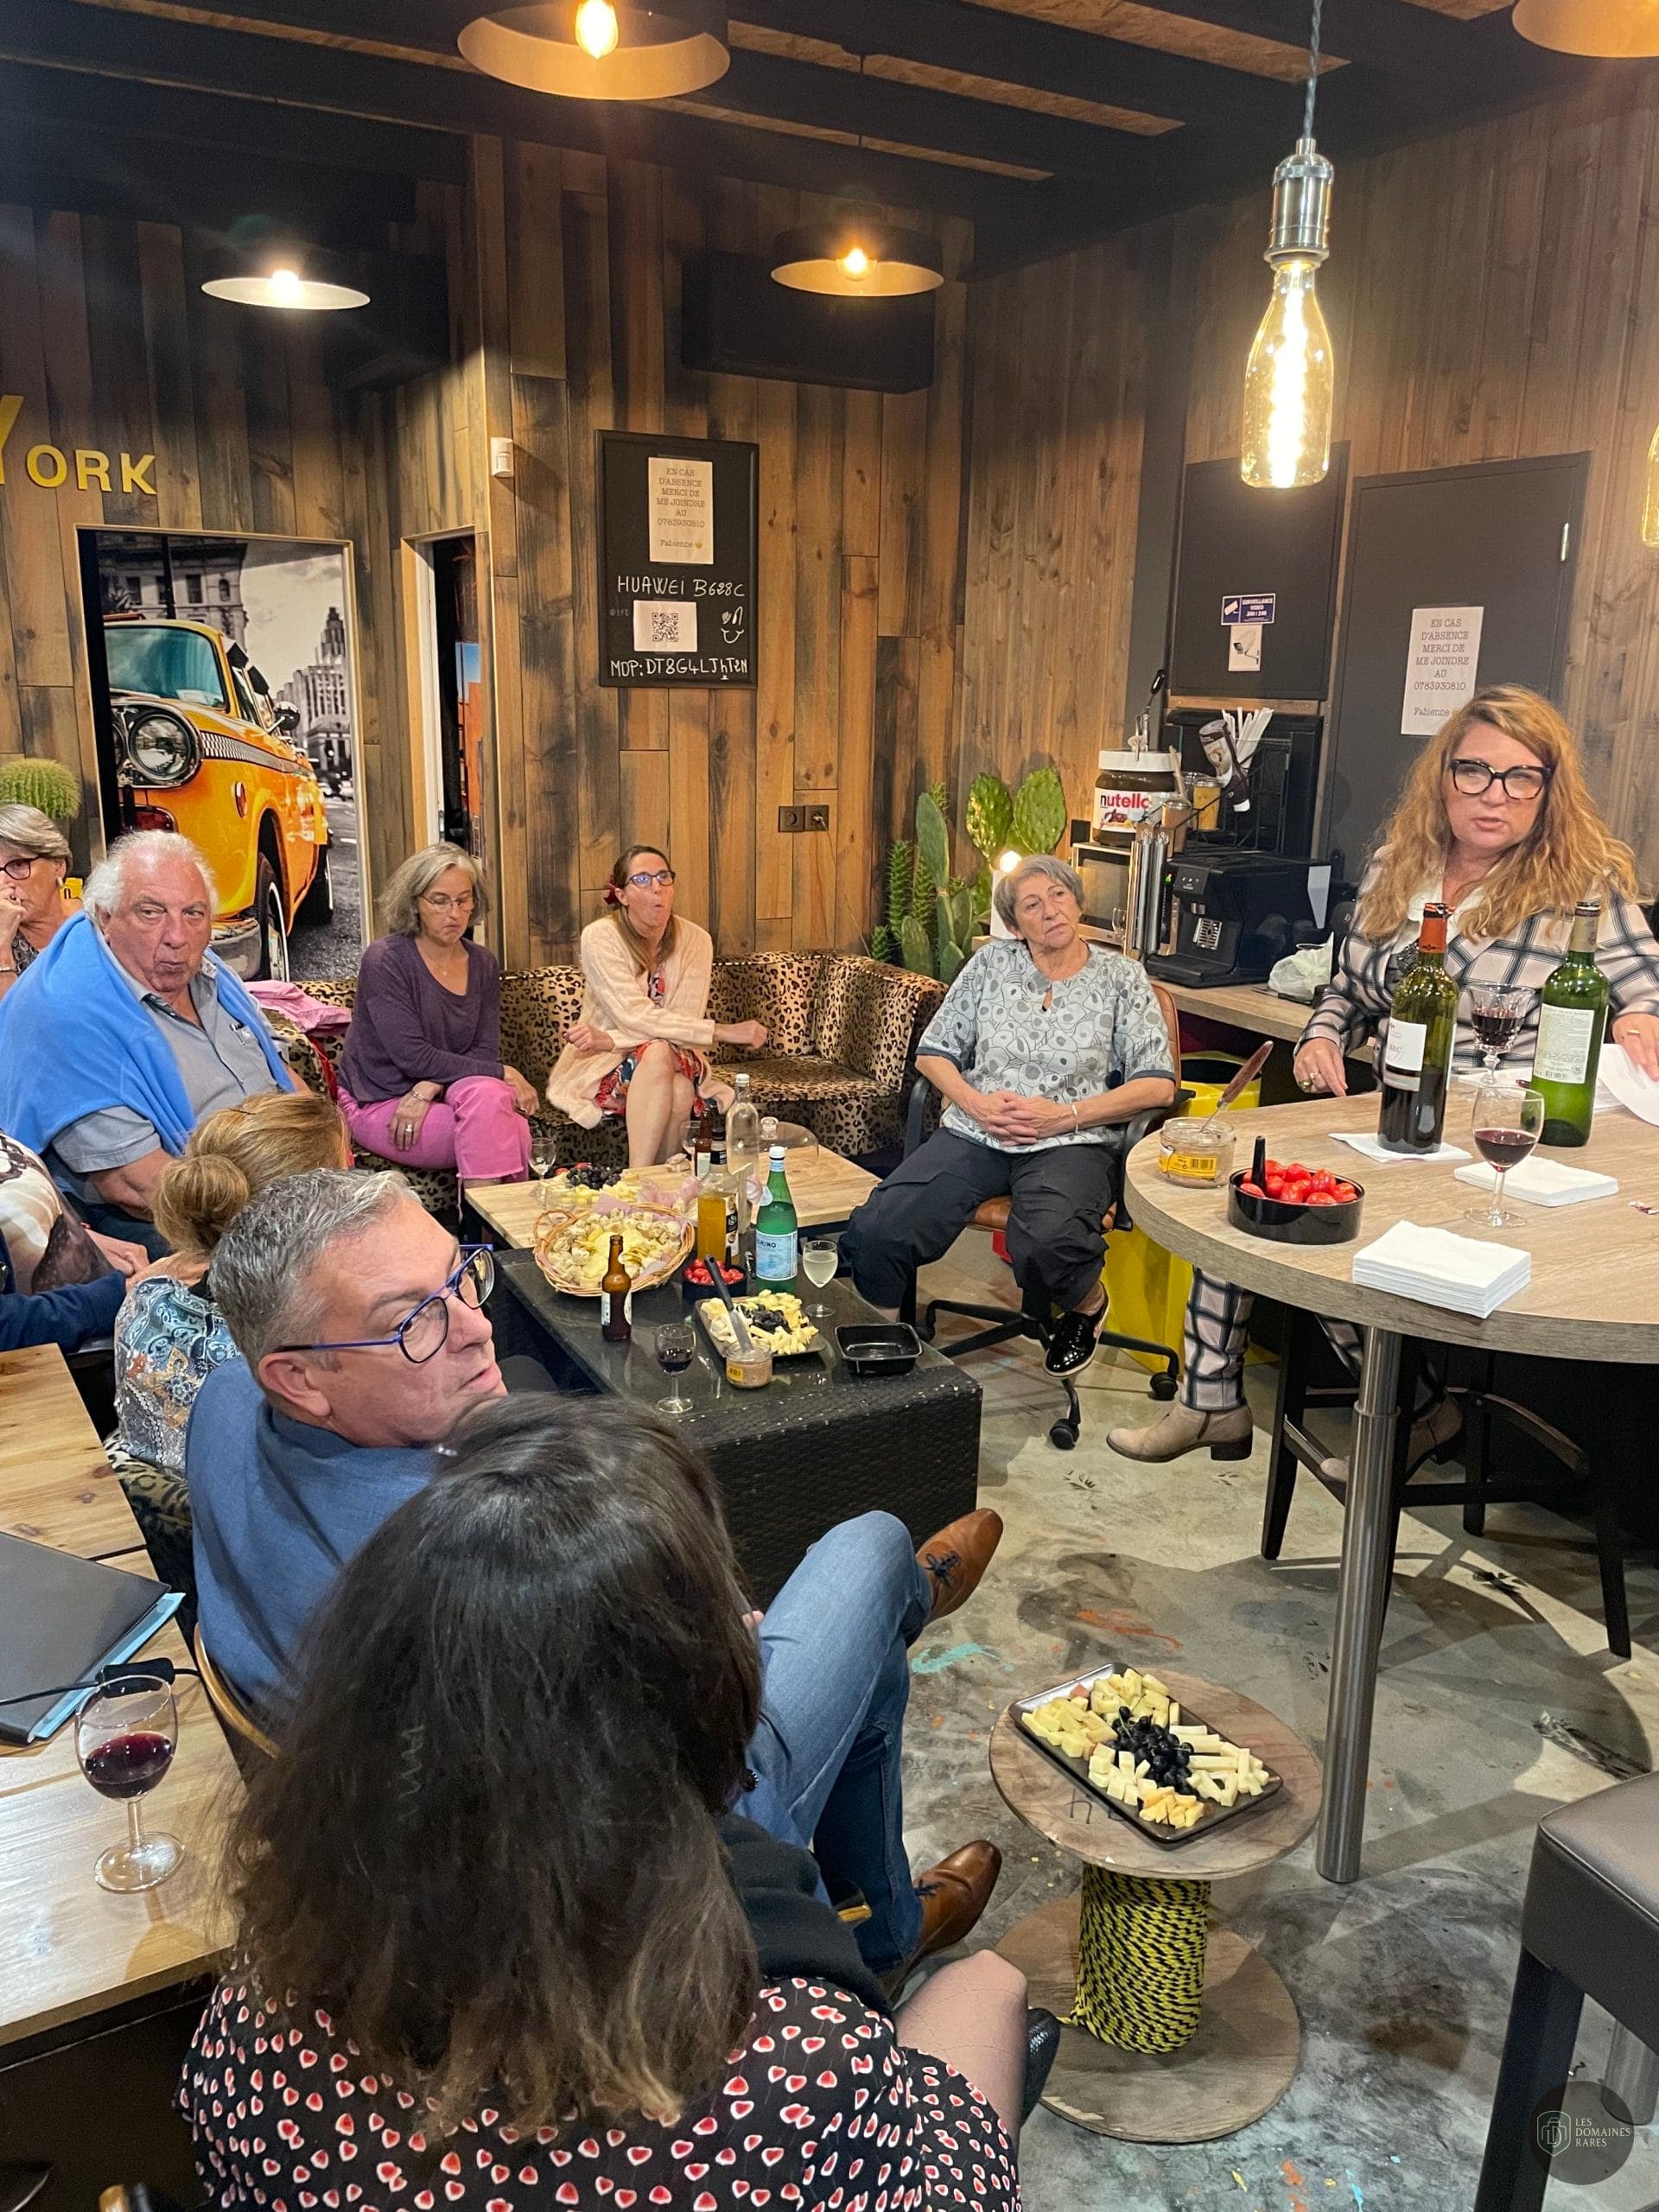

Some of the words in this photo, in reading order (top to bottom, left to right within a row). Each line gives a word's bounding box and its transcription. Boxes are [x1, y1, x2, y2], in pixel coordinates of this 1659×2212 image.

[659, 478, 702, 487] D'ABSENCE
[662, 488, 687, 497] MERCI
[671, 499, 705, 508] JOINDRE
[1430, 620, 1442, 628] EN
[1444, 619, 1462, 627] CAS
[1421, 631, 1469, 641] D'ABSENCE
[1422, 645, 1451, 653] MERCI
[1415, 657, 1429, 665] ME
[1431, 657, 1470, 665] JOINDRE
[1434, 670, 1447, 678] AU
[1414, 682, 1466, 690] 0783930810
[1414, 707, 1451, 716] Fabienne
